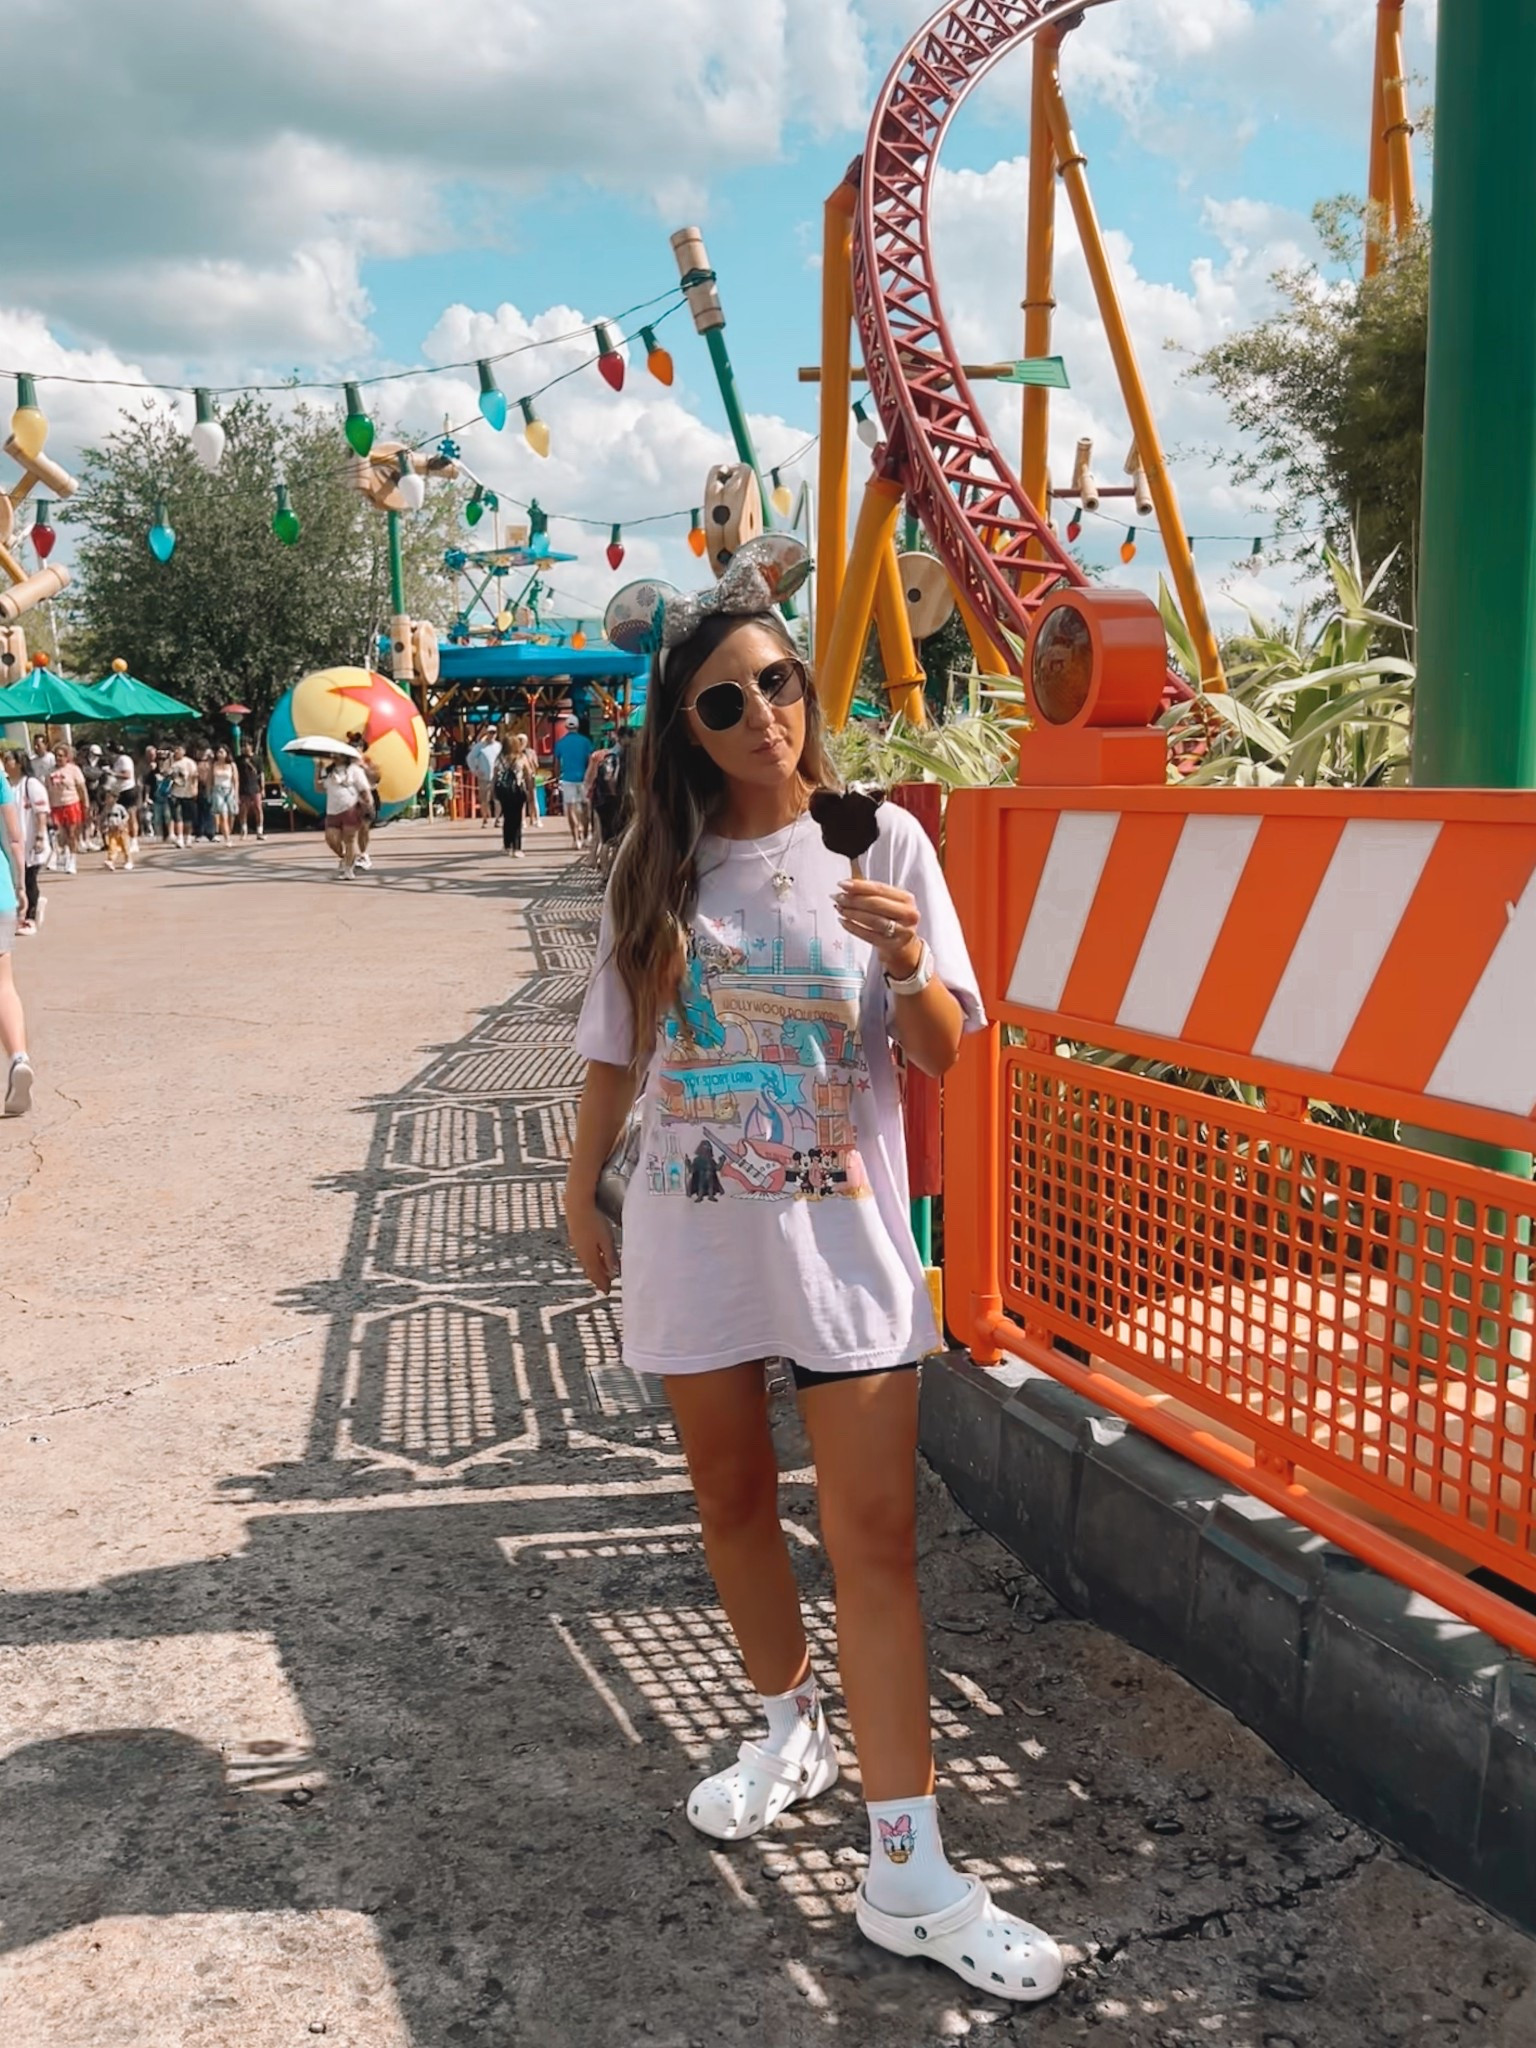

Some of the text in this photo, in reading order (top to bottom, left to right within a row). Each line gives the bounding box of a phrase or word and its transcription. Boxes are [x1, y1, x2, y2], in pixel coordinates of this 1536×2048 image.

[723, 998, 785, 1017] HOLLYWOOD
[683, 1071, 754, 1087] TOY STORY LAND
